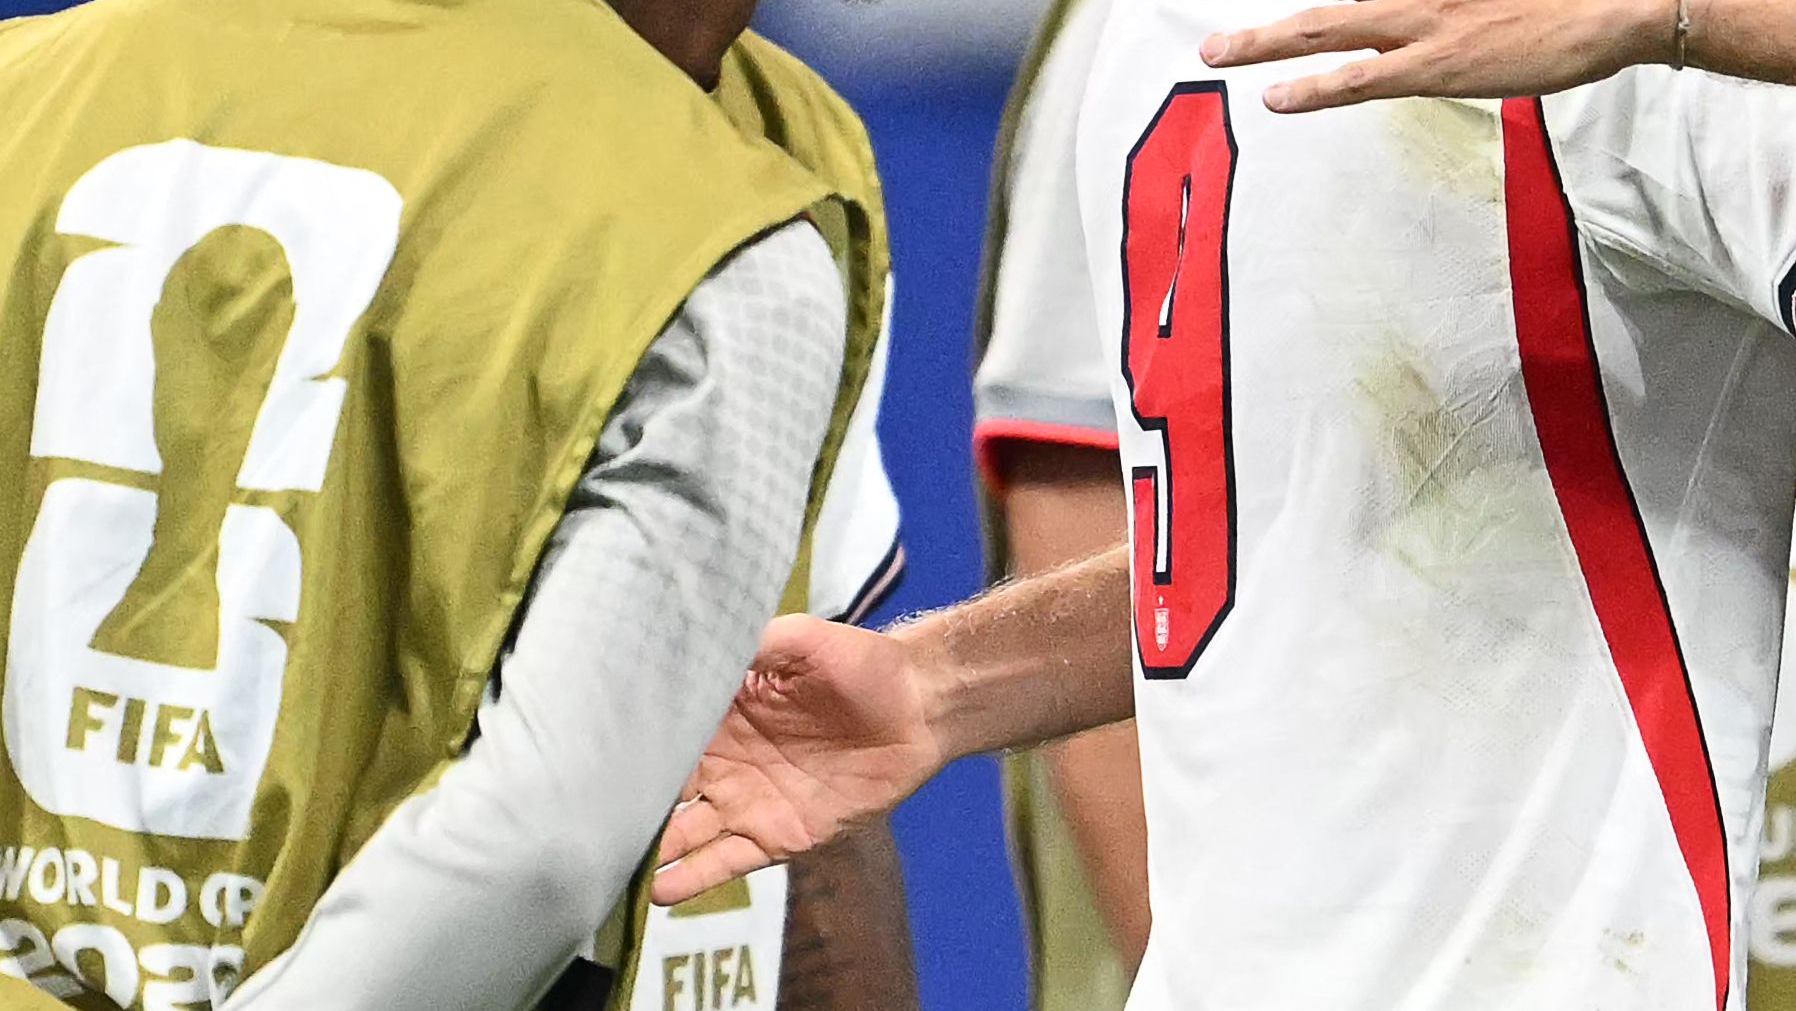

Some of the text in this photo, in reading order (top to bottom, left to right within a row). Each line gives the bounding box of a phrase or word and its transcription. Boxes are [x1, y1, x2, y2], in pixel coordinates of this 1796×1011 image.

[1121, 79, 1239, 680] 9
[65, 685, 225, 775] FIFA
[0, 845, 188, 924] WORLD
[662, 944, 757, 1011] FIFA
